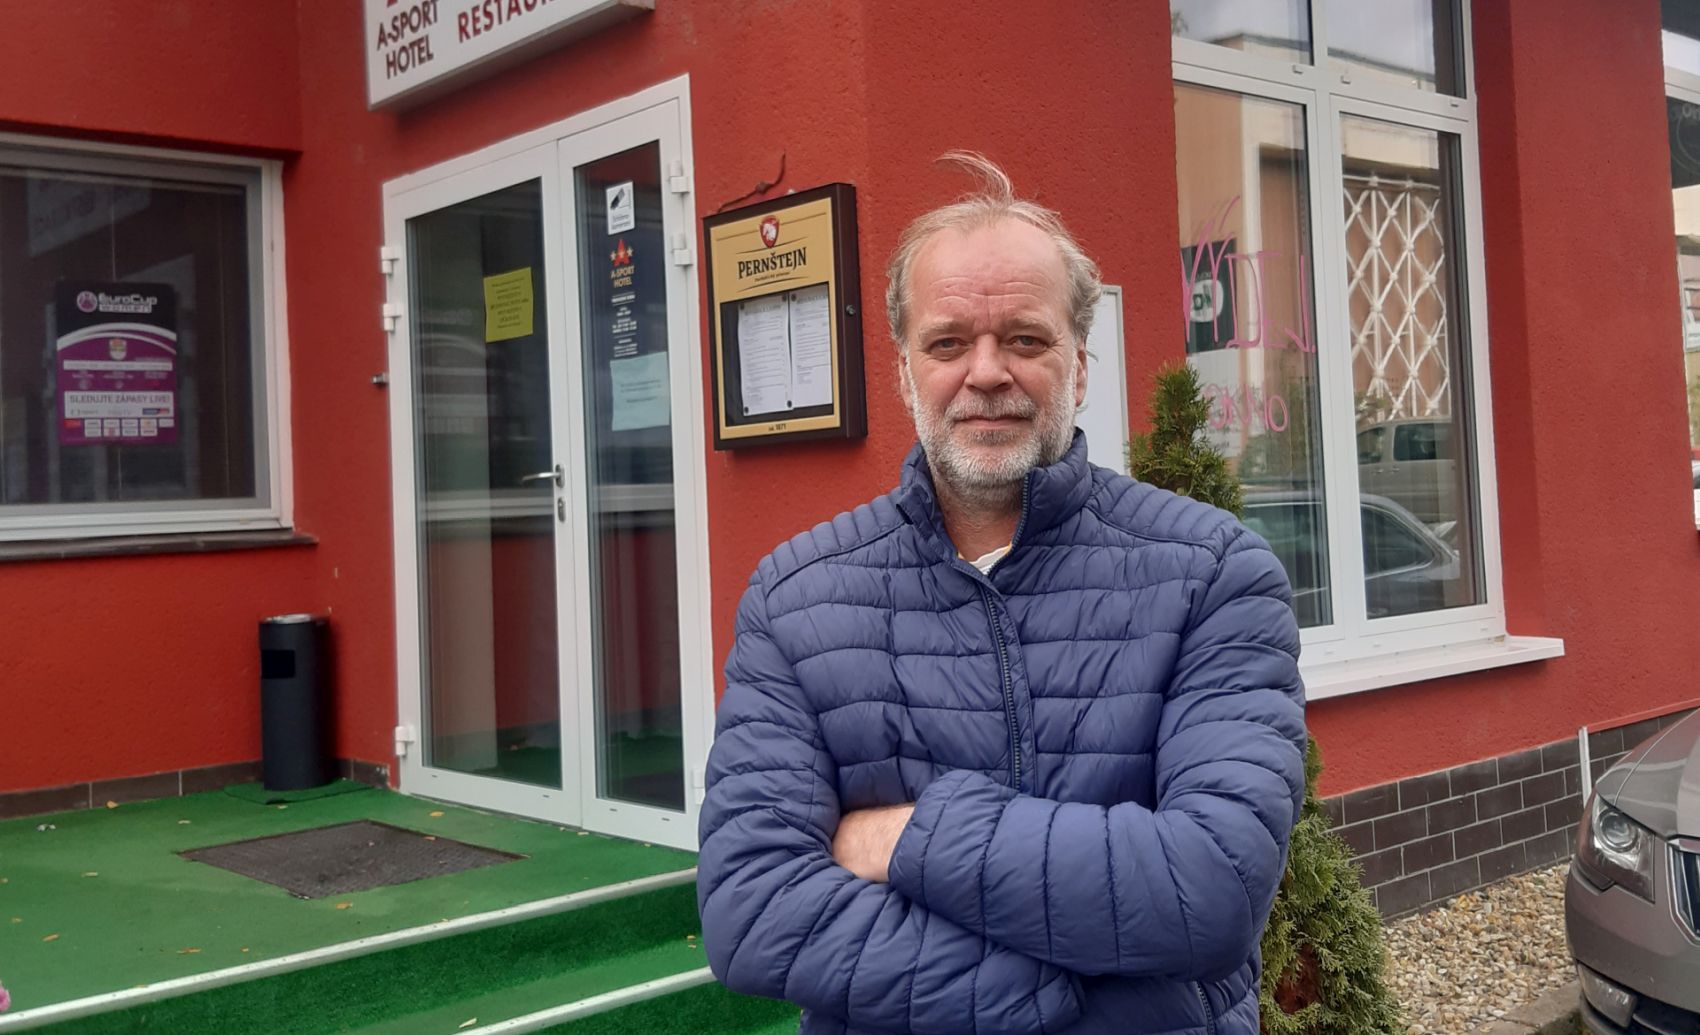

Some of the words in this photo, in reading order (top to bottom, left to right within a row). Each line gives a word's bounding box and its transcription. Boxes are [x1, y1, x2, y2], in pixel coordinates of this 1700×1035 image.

[377, 0, 438, 51] A-SPORT
[386, 35, 434, 80] HOTEL
[738, 247, 807, 280] PERNŠTEJN
[610, 265, 635, 279] A-SPORT
[613, 276, 633, 288] HOTEL
[98, 293, 157, 305] EuroCup
[69, 394, 112, 404] SLEDUJTE
